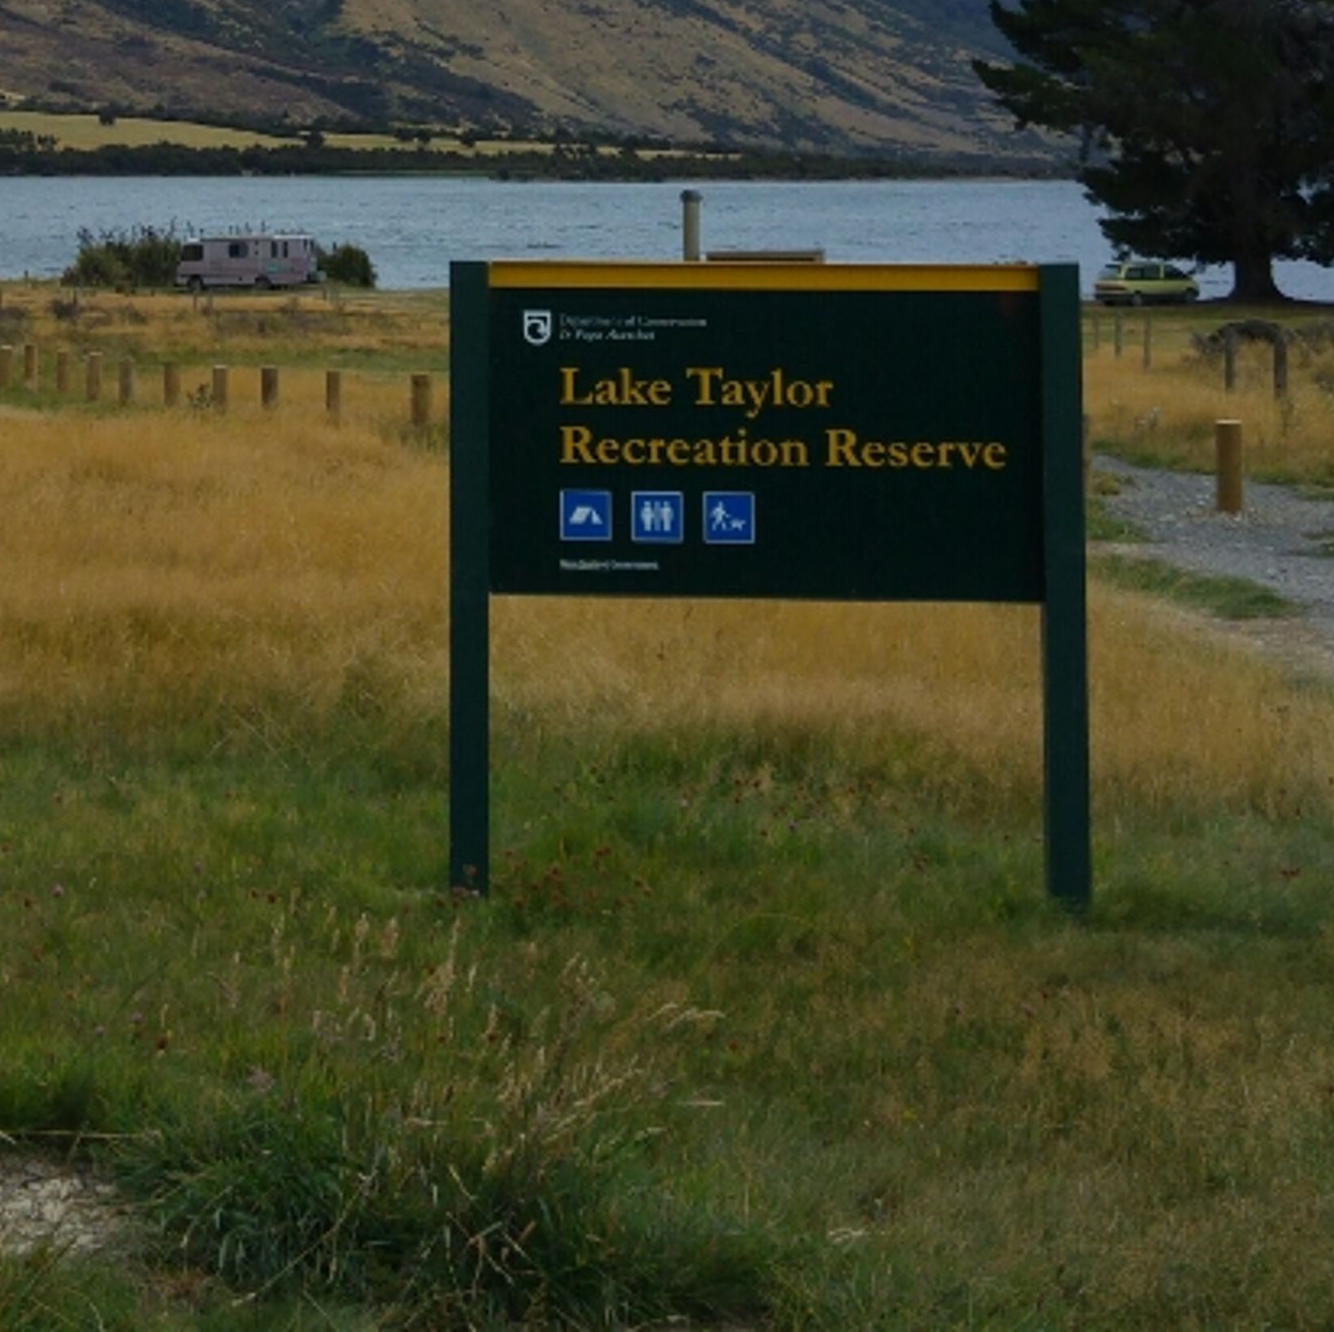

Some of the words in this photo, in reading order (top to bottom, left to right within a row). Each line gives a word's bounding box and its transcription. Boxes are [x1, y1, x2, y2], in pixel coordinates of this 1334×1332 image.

[560, 367, 672, 406] Lake
[687, 367, 834, 417] Taylor
[560, 426, 809, 467] Recreation
[824, 428, 1007, 469] Reserve
